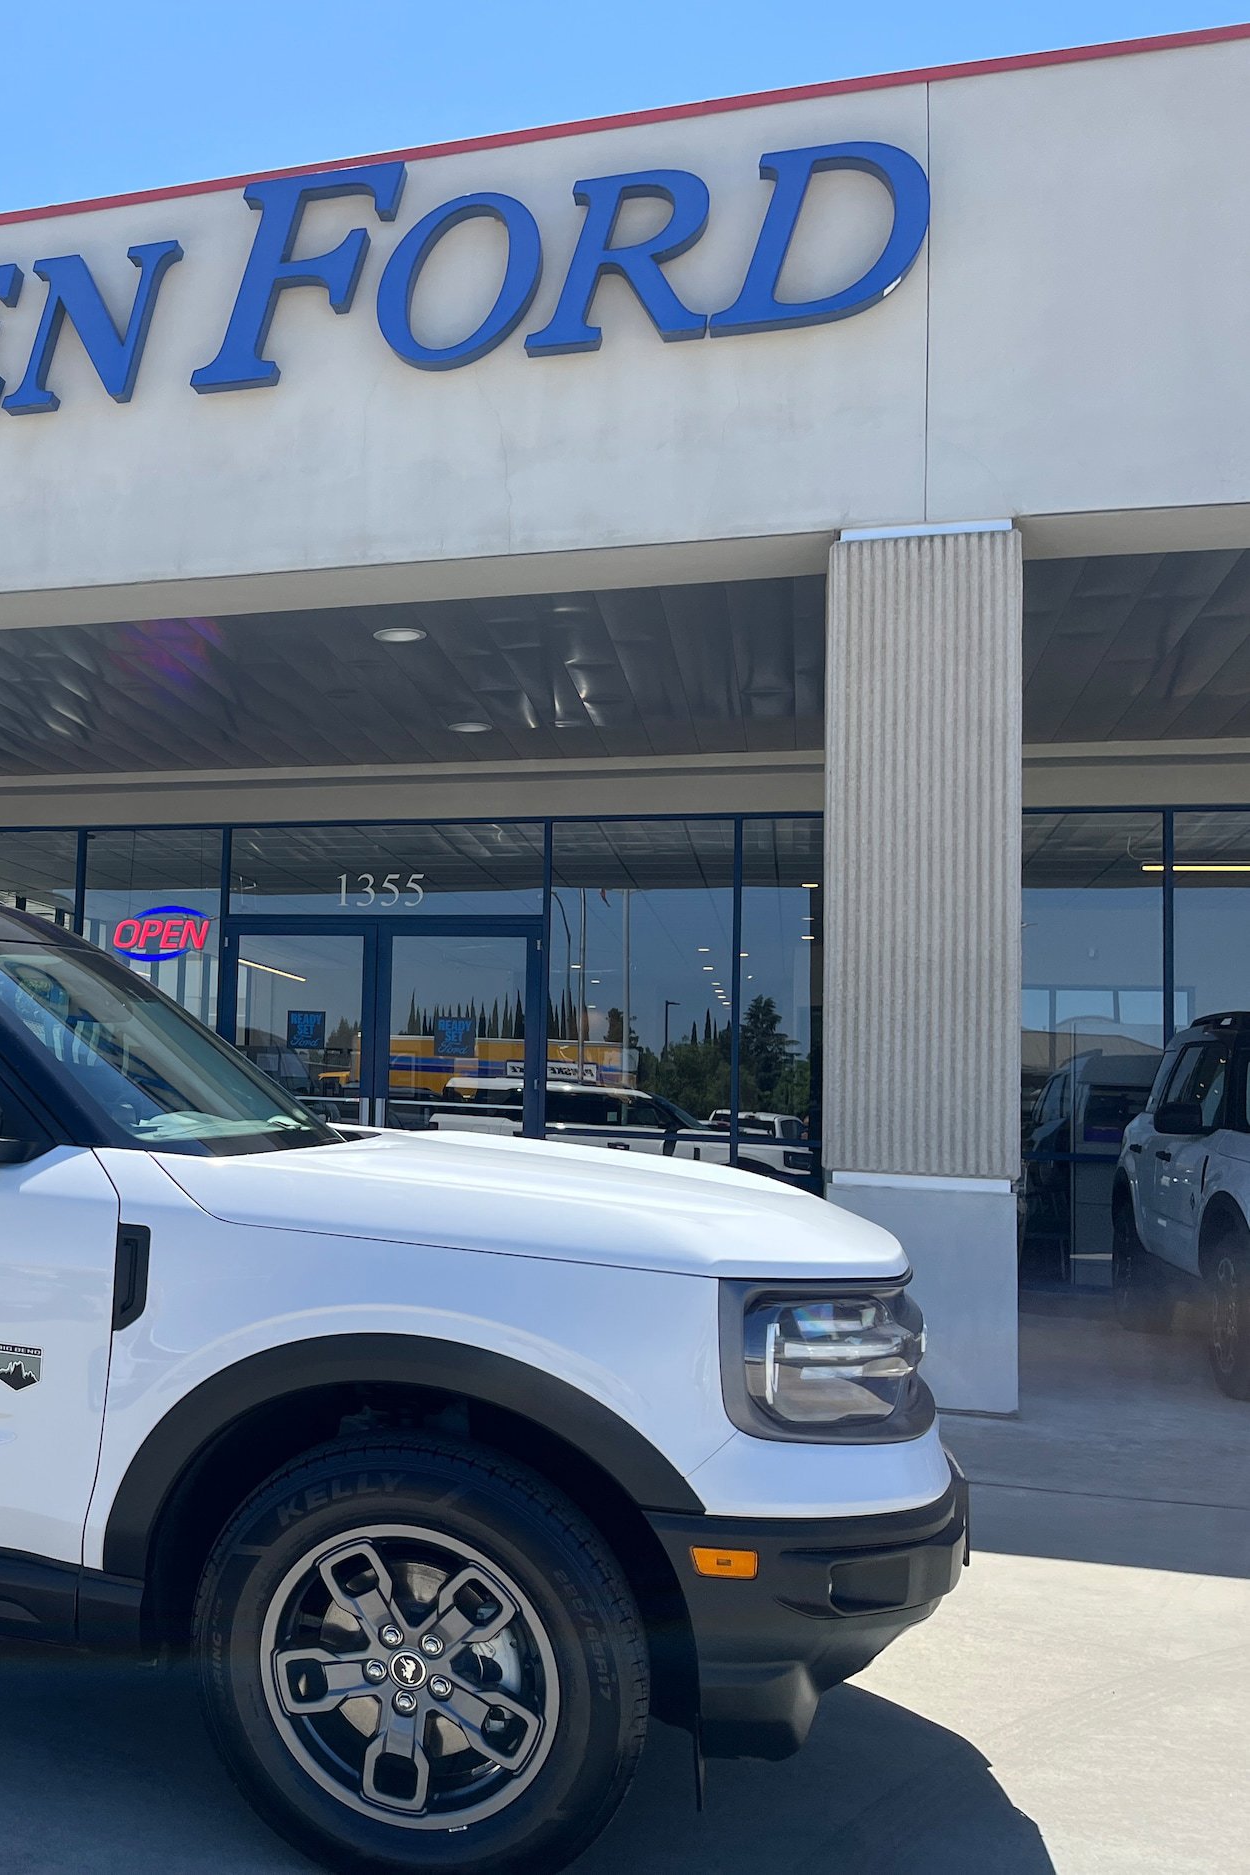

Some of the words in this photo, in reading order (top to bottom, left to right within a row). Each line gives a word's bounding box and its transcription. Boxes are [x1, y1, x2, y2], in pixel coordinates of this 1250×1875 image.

[190, 140, 930, 395] FORD
[337, 873, 425, 907] 1355
[113, 918, 210, 949] OPEN
[291, 1013, 322, 1025] READY
[297, 1024, 315, 1036] SET
[438, 1020, 471, 1031] READY
[290, 1035, 319, 1047] Ford
[446, 1030, 463, 1042] SET
[438, 1041, 469, 1055] Ford
[14, 1347, 41, 1356] BEND
[276, 1472, 406, 1527] KELLY
